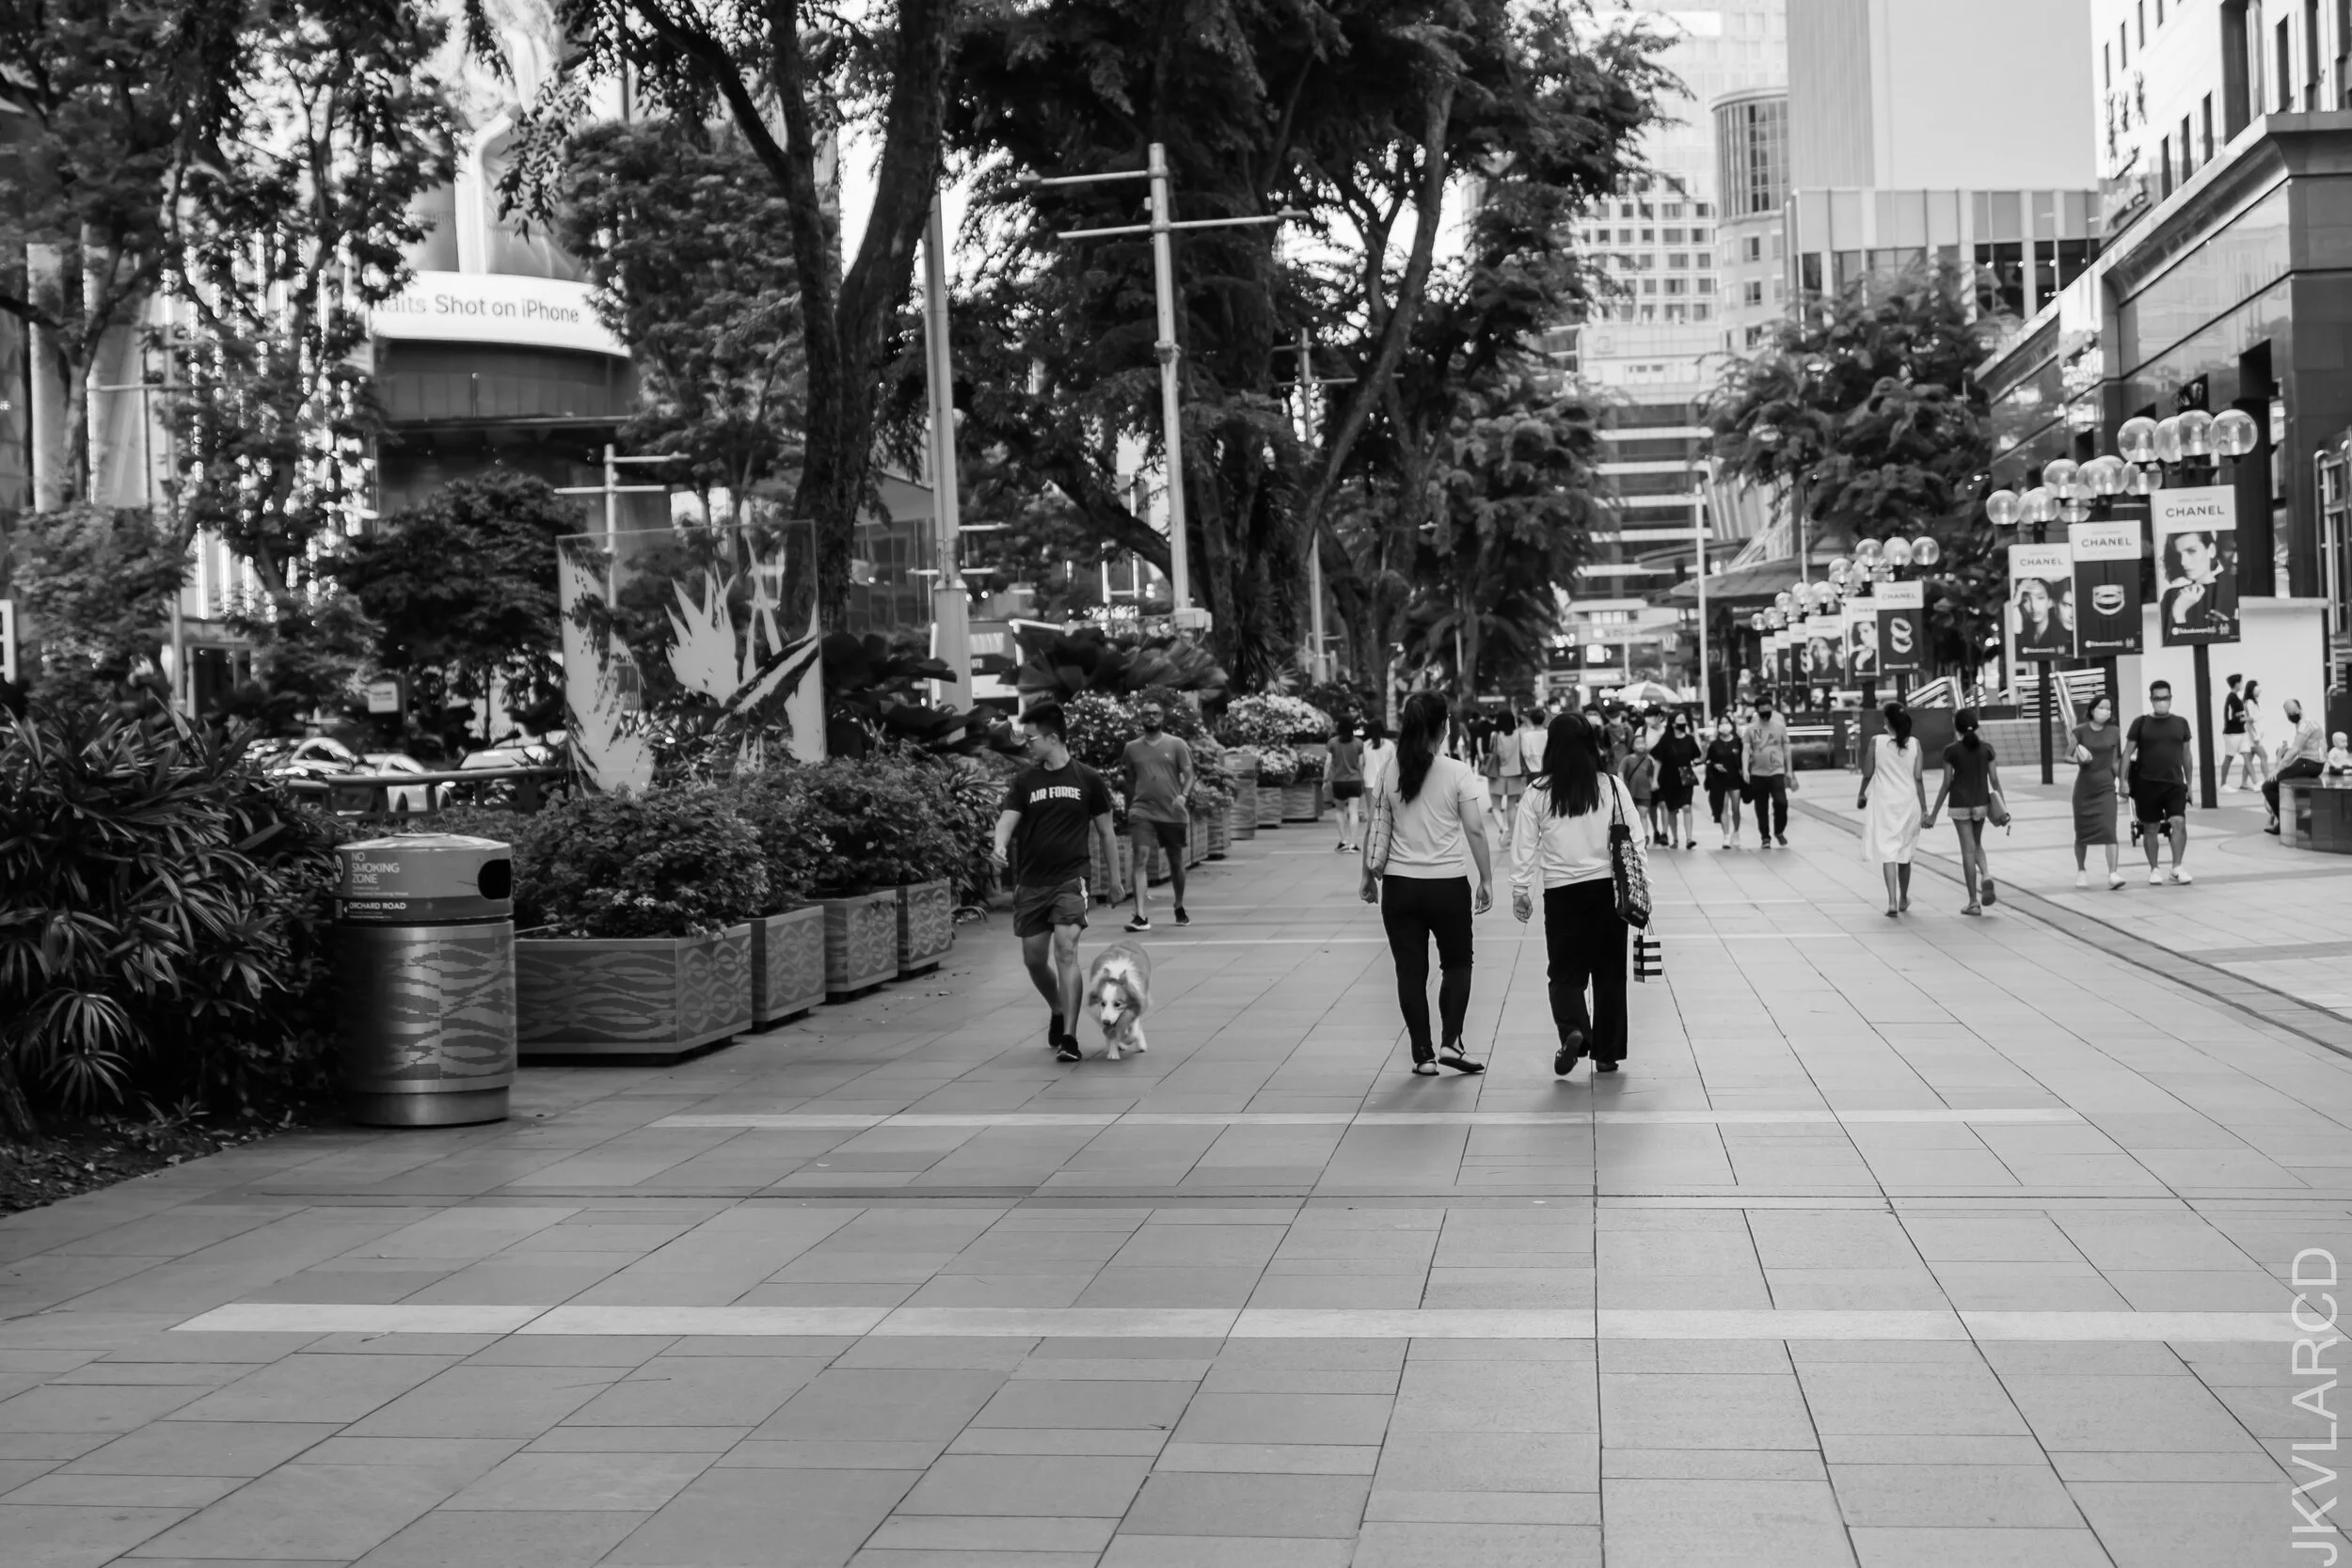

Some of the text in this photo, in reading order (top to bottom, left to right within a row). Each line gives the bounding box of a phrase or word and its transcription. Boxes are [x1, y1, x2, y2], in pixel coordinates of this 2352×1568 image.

[435, 293, 486, 316] Shot
[492, 302, 516, 317] on
[521, 298, 580, 324] iPhone
[2165, 504, 2226, 518] CHANEL
[2081, 536, 2133, 548] CHANEL
[2019, 556, 2064, 567] CHANEL
[1029, 786, 1082, 804] AIR FORCE
[351, 851, 366, 862] NO
[352, 863, 401, 874] SMOKING
[352, 874, 378, 884] ZONE
